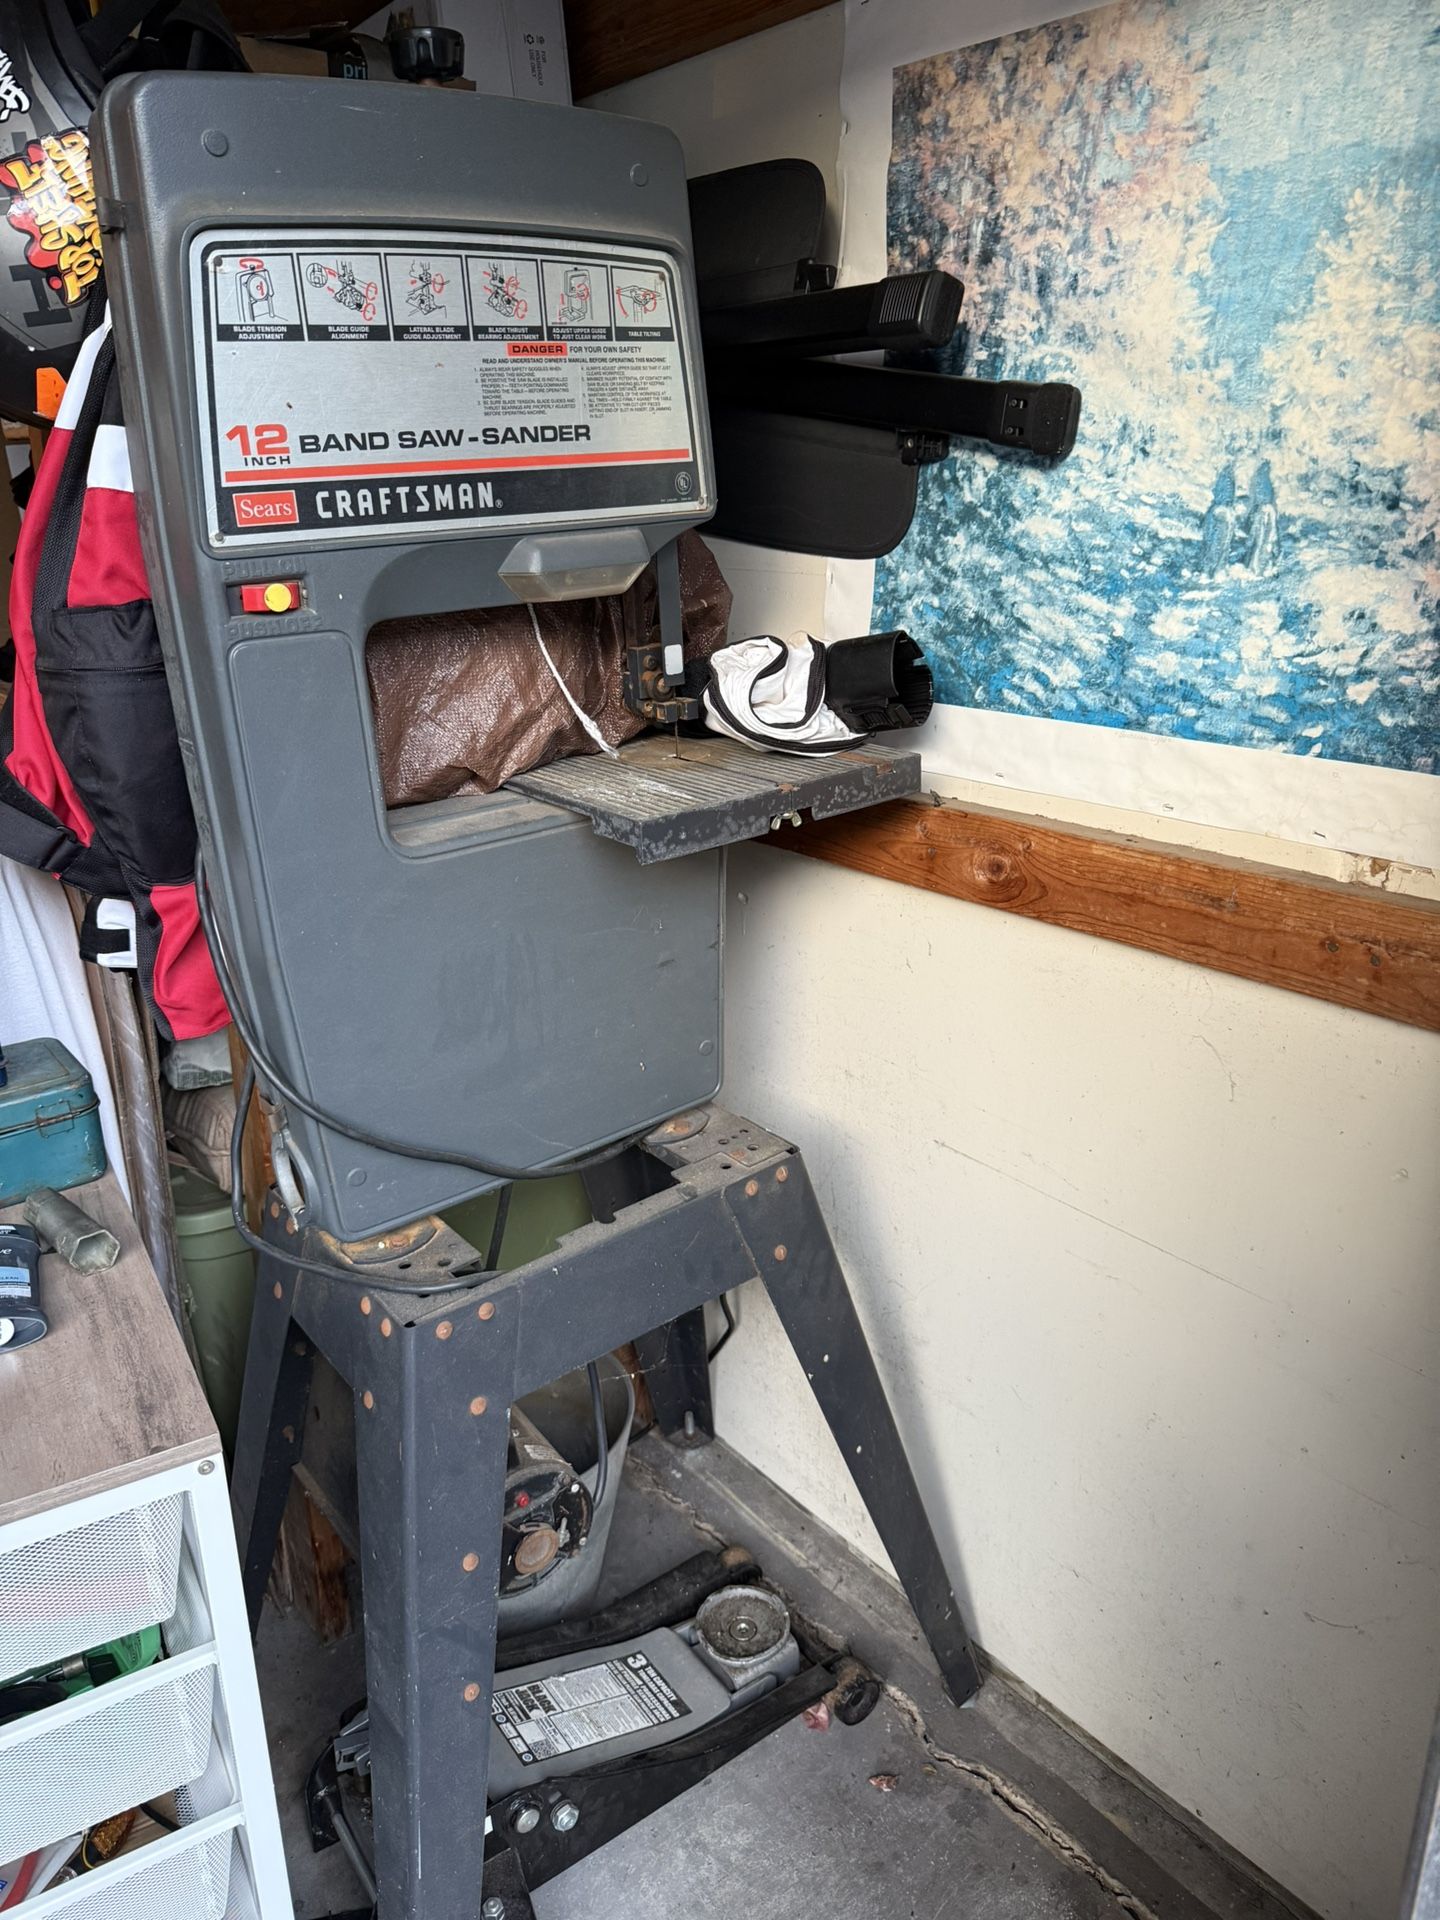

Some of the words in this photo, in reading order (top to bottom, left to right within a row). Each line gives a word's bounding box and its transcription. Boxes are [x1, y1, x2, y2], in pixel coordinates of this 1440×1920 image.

[535, 50, 545, 86] HOUSEHOLD
[512, 345, 563, 353] DANGER
[226, 424, 290, 456] 12
[299, 432, 389, 453] BAND
[244, 456, 291, 466] INCH
[240, 499, 294, 518] Sears
[223, 559, 273, 582] PULL
[226, 620, 282, 640] PUSH
[627, 1654, 648, 1669] 3
[645, 1666, 658, 1678] TON
[653, 1676, 678, 1701] CAPACITY
[515, 1689, 542, 1713] JACK
[527, 1684, 558, 1714] BLACK
